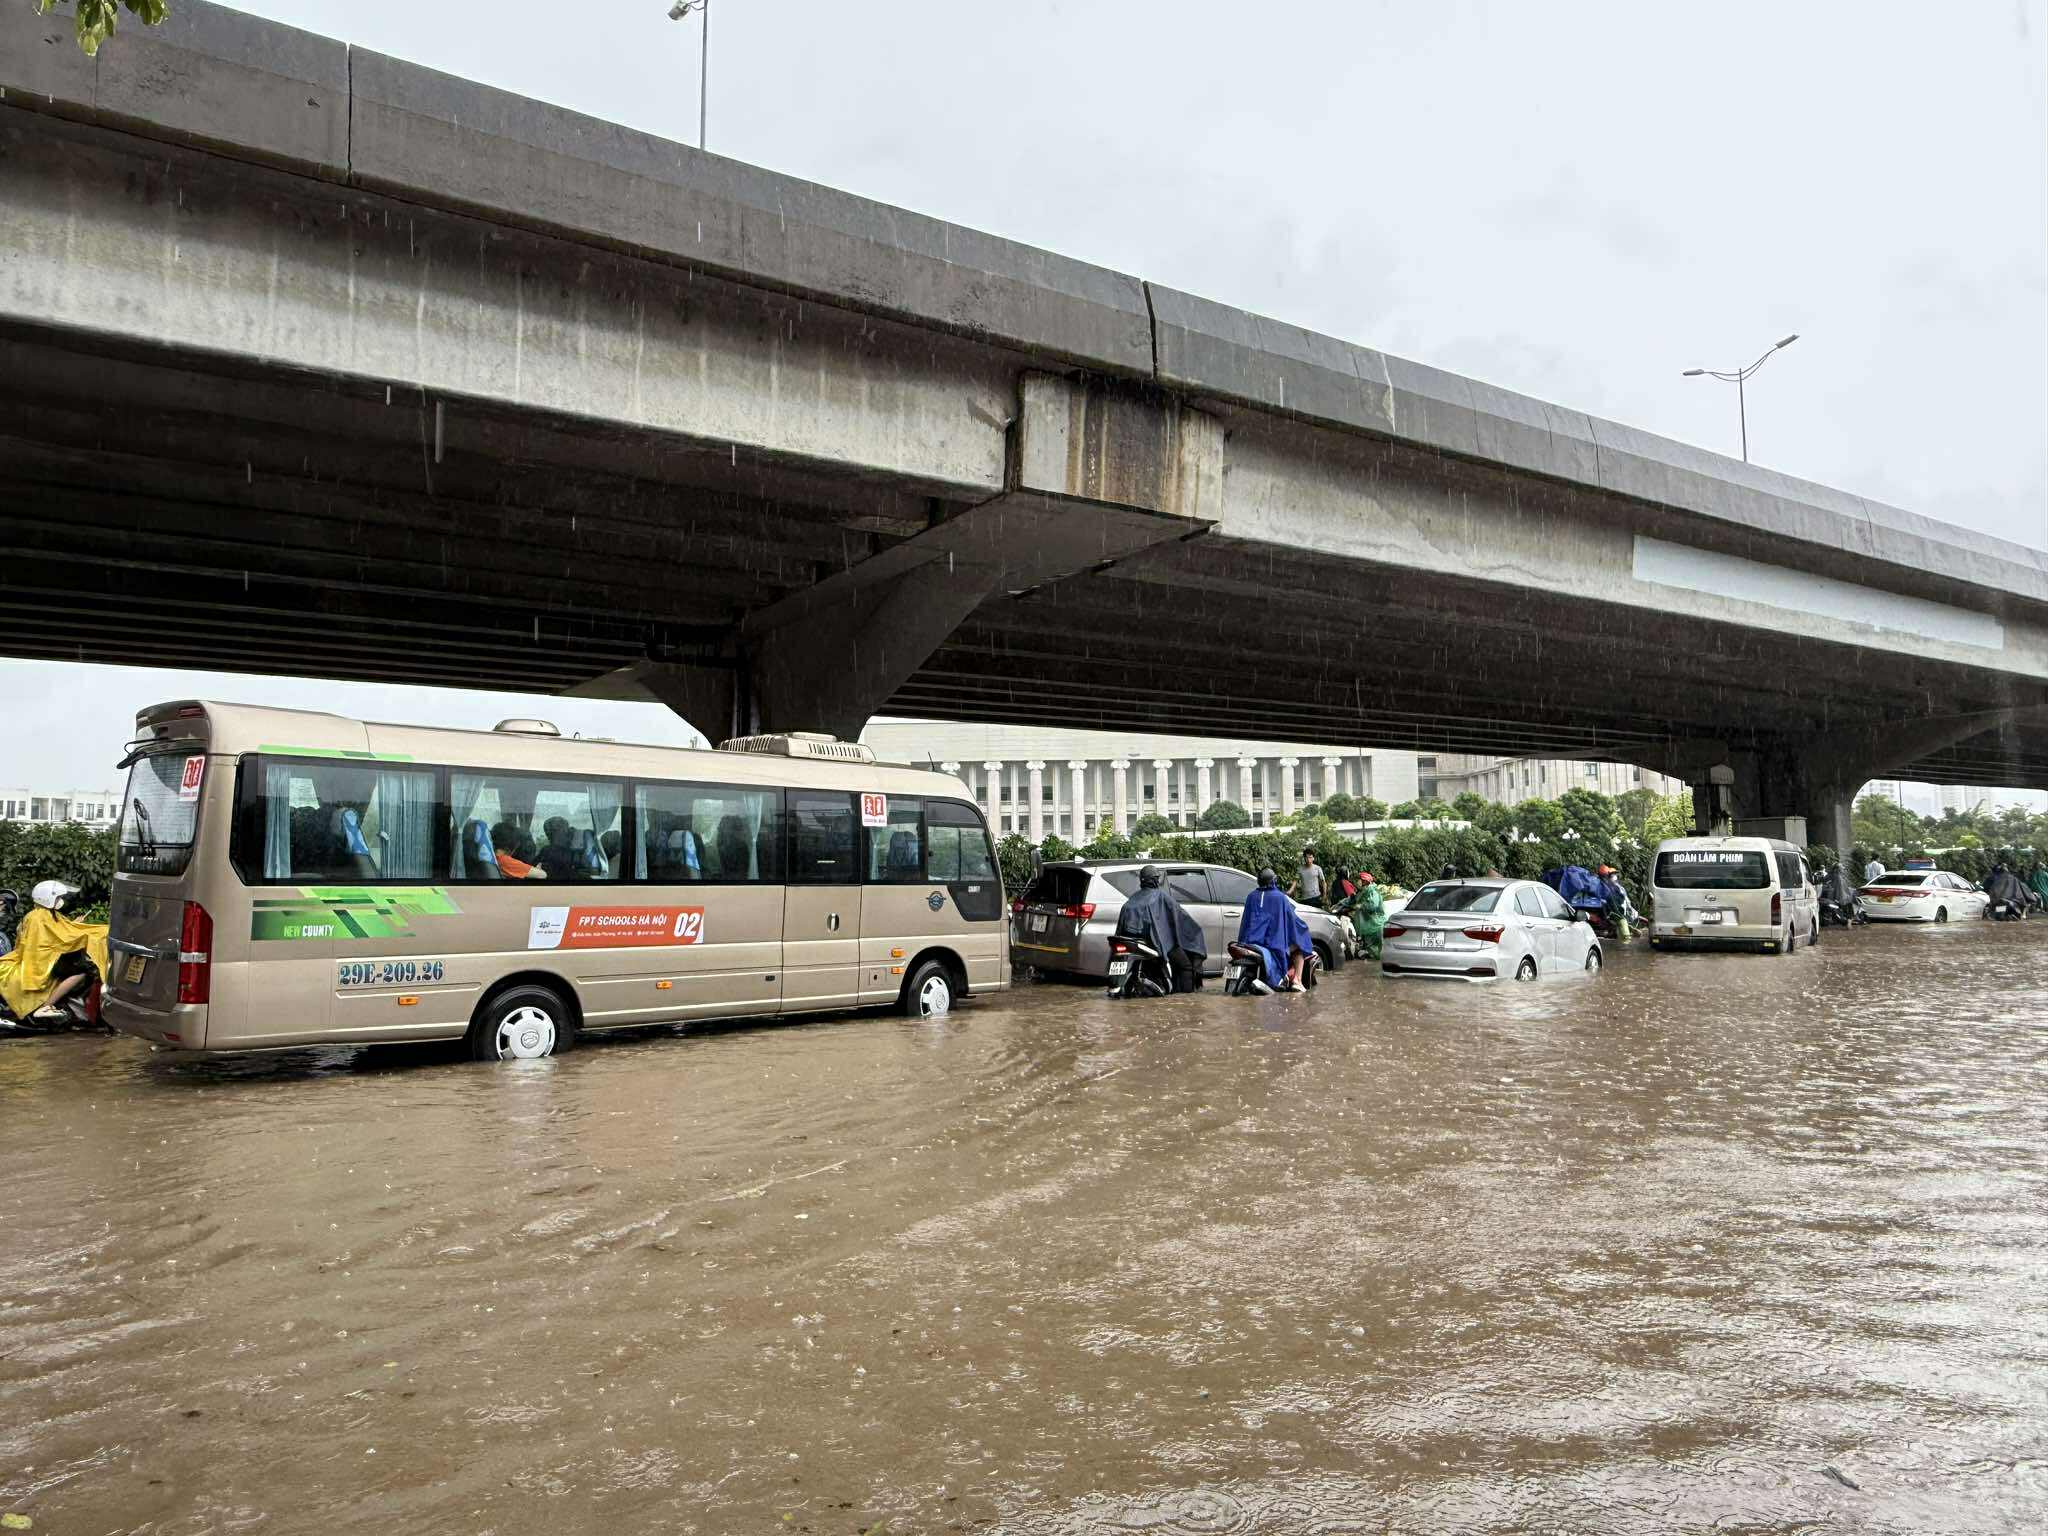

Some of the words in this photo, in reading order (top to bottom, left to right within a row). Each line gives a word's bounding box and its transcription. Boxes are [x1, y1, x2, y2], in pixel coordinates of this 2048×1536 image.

[1719, 853, 1744, 863] PHIM
[579, 915, 597, 926] FPT
[597, 914, 638, 926] SCHOOLS
[638, 913, 651, 926] HÀ
[652, 912, 668, 926] NỘI
[673, 912, 701, 938] 02
[283, 925, 301, 937] NEW
[302, 924, 335, 937] COUNTY
[339, 960, 444, 985] 29E-209.26
